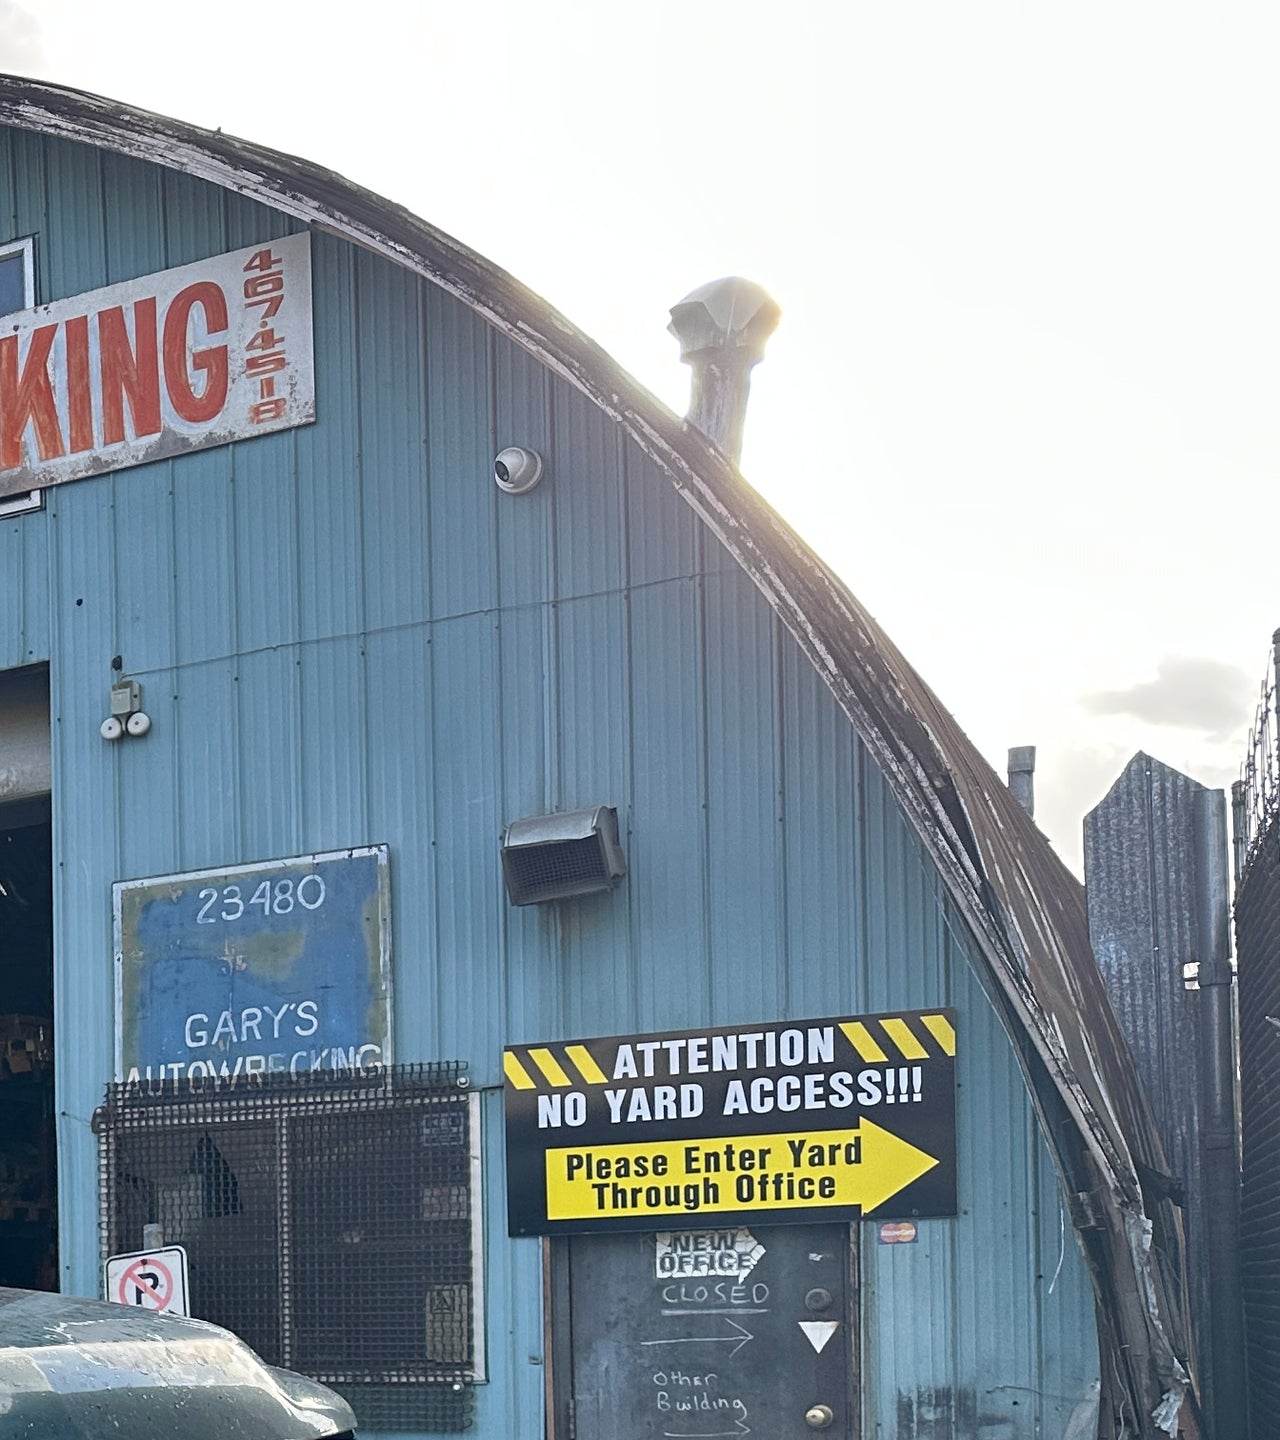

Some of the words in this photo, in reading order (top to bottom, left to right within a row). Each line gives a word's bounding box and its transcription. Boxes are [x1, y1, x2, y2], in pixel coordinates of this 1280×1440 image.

[196, 874, 326, 924] 23480
[184, 1000, 319, 1048] GARY'S
[613, 1026, 835, 1080] ATTENTION
[536, 1092, 587, 1129] NO
[605, 1083, 704, 1124] YARD
[722, 1066, 923, 1116] ACCESS!!!
[566, 1152, 668, 1182] Please
[684, 1144, 771, 1174] Enter
[786, 1136, 862, 1168] Yard
[592, 1176, 719, 1211] Through
[736, 1171, 836, 1202] Office
[659, 1251, 752, 1274] OFFICE
[672, 1233, 737, 1252] NEW
[662, 1283, 770, 1304] CLOSED
[657, 1391, 748, 1421] Building
